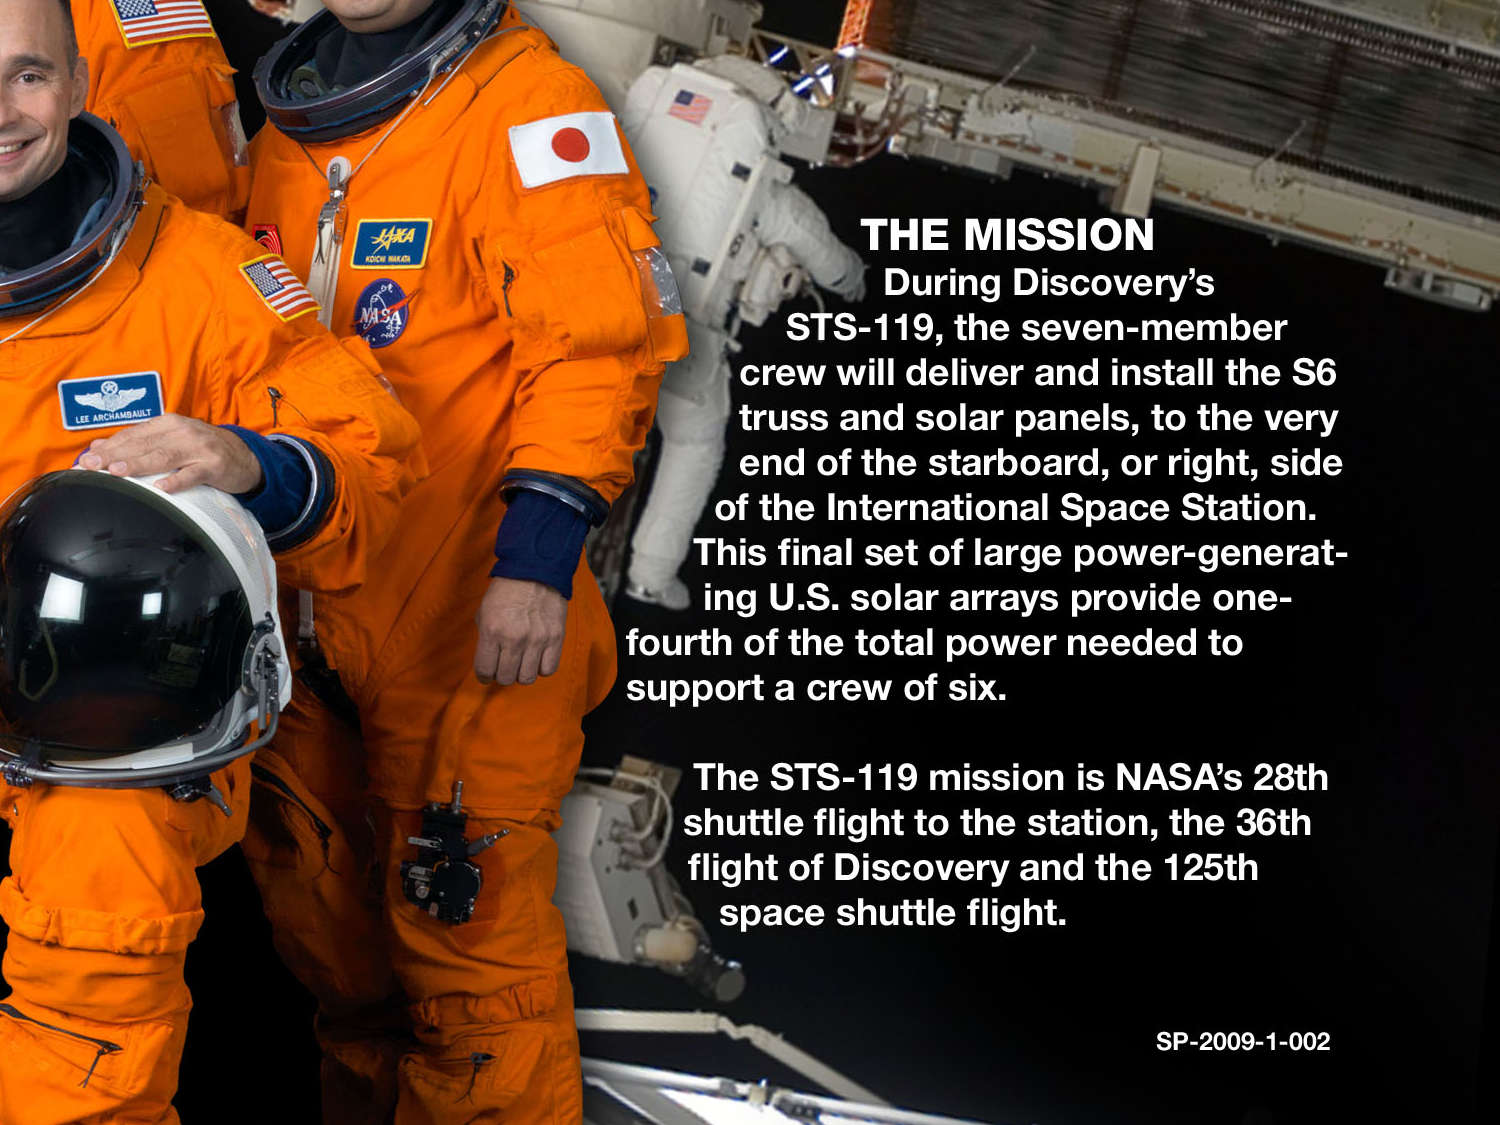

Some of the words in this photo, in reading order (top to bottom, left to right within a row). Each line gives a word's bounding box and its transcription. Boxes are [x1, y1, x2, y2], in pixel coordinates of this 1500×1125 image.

[360, 307, 402, 325] NASA
[76, 415, 89, 423] LEE
[93, 409, 152, 422] ARCHAMBAULT
